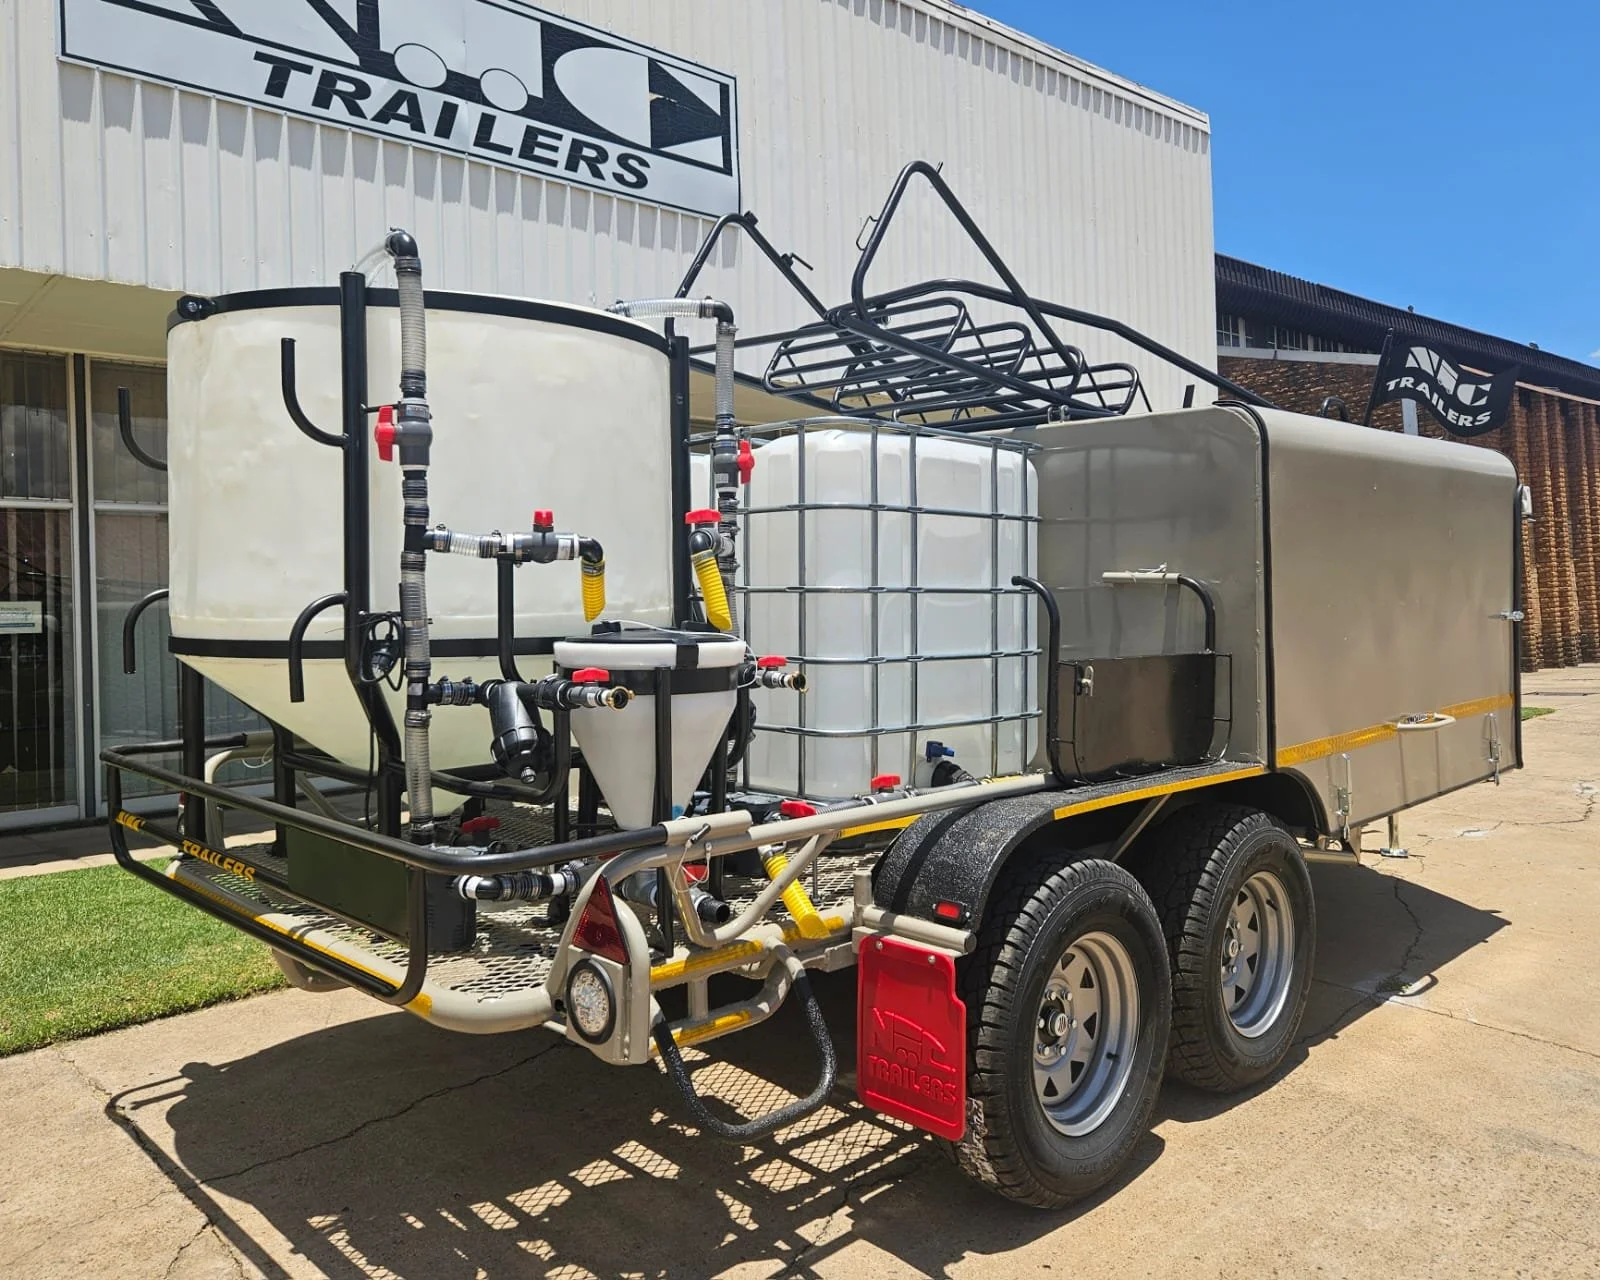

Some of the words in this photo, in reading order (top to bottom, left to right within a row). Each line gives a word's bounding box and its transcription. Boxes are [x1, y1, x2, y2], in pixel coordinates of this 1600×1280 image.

[253, 51, 651, 190] TRAILERS
[1386, 376, 1492, 427] TRAILERS
[182, 839, 256, 883] TRAILERS
[867, 1054, 957, 1105] TRAILERS
